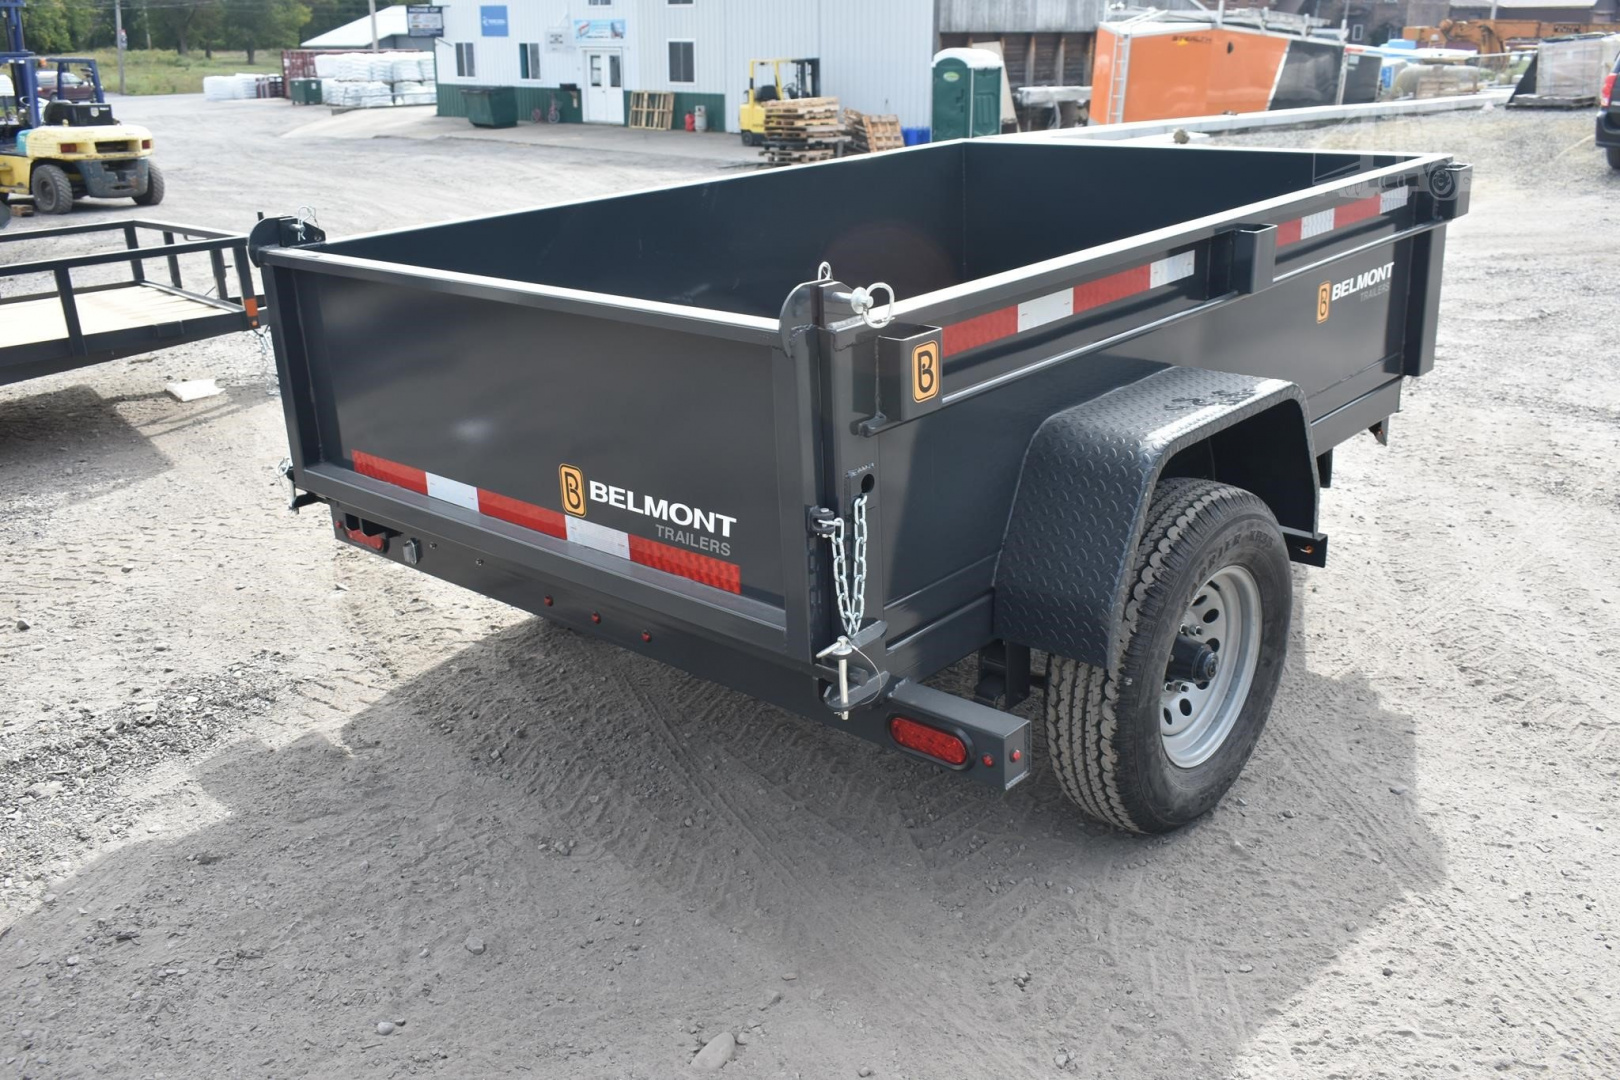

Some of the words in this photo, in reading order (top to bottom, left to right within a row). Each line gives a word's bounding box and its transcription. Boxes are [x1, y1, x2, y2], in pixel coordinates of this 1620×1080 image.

[1332, 262, 1394, 301] BELMONT
[1360, 282, 1390, 302] TRAILERS
[590, 480, 737, 538] BELMONT
[655, 523, 731, 557] TRAILERS
